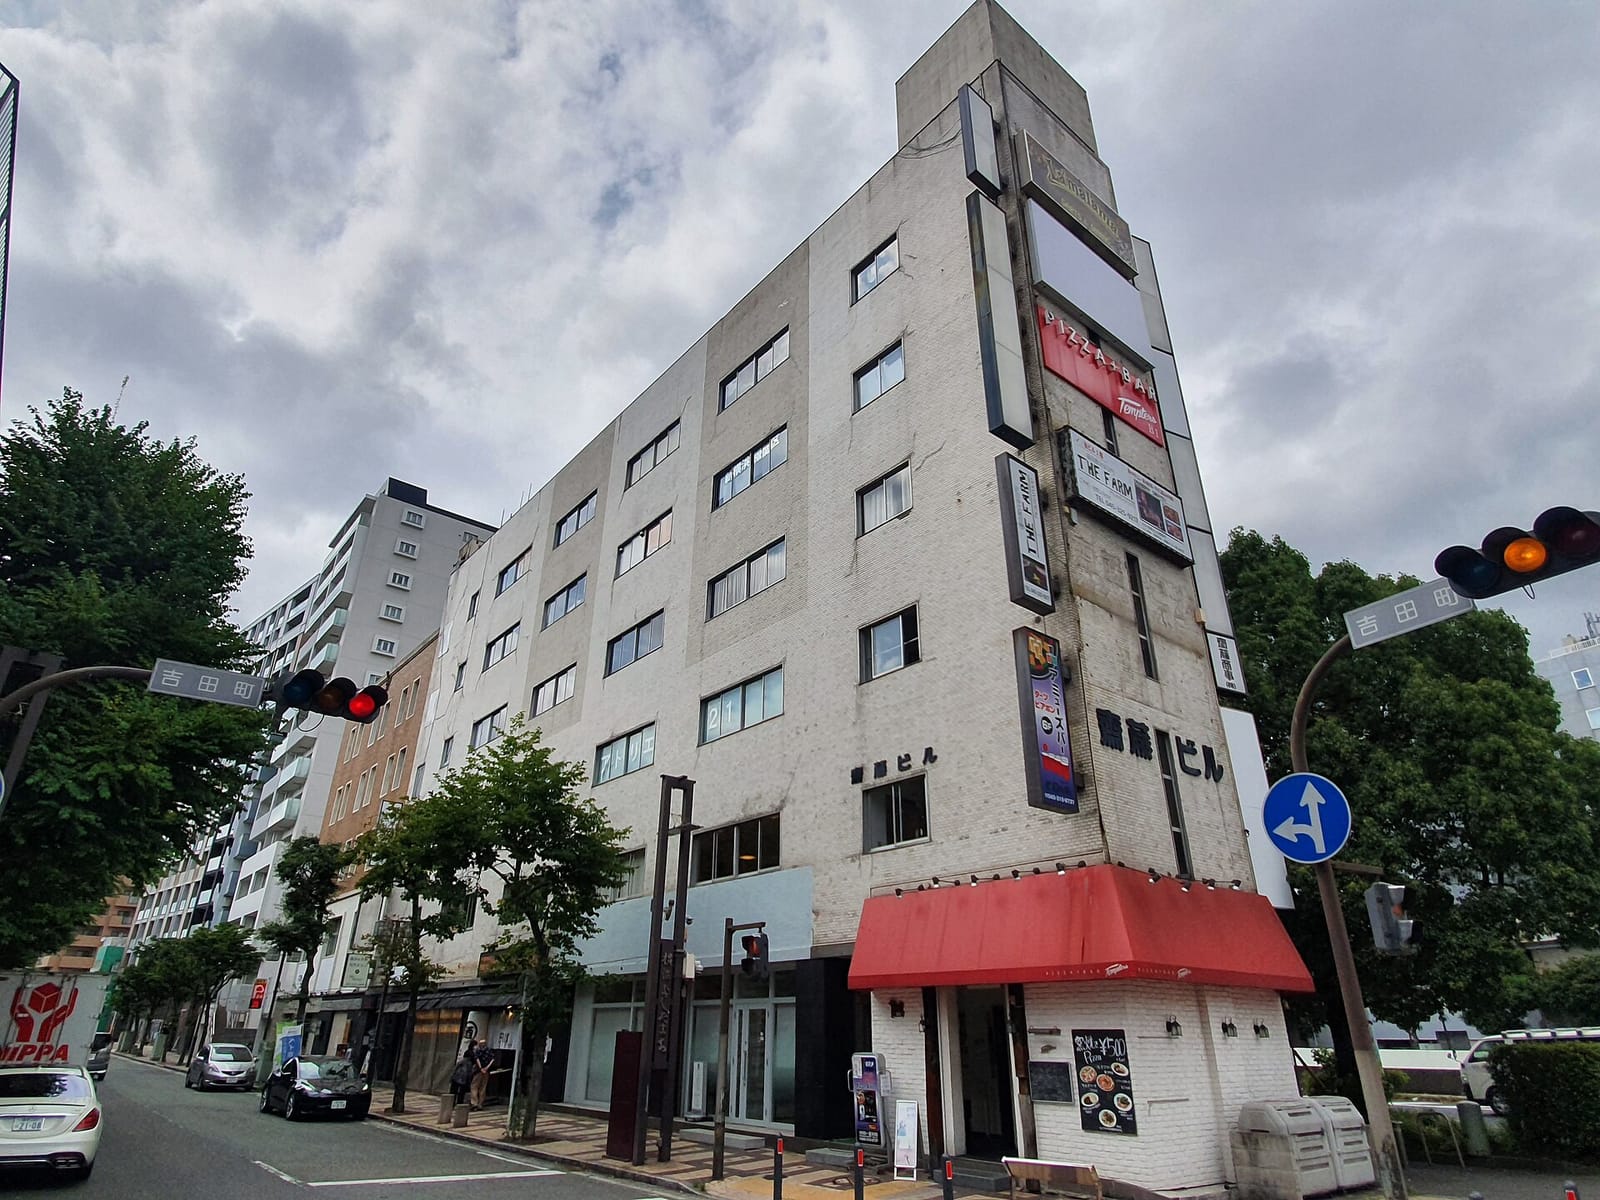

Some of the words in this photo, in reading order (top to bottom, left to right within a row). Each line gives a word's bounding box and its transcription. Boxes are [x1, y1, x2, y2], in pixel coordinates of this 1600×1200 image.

[1018, 469, 1033, 515] FARM
[1077, 454, 1101, 481] THE
[1103, 471, 1134, 500] FARM
[1023, 517, 1037, 555] THE
[1355, 586, 1459, 637] 吉田町
[161, 668, 256, 700] 吉田町
[600, 736, 655, 782] アトリエ
[708, 700, 732, 730] 21
